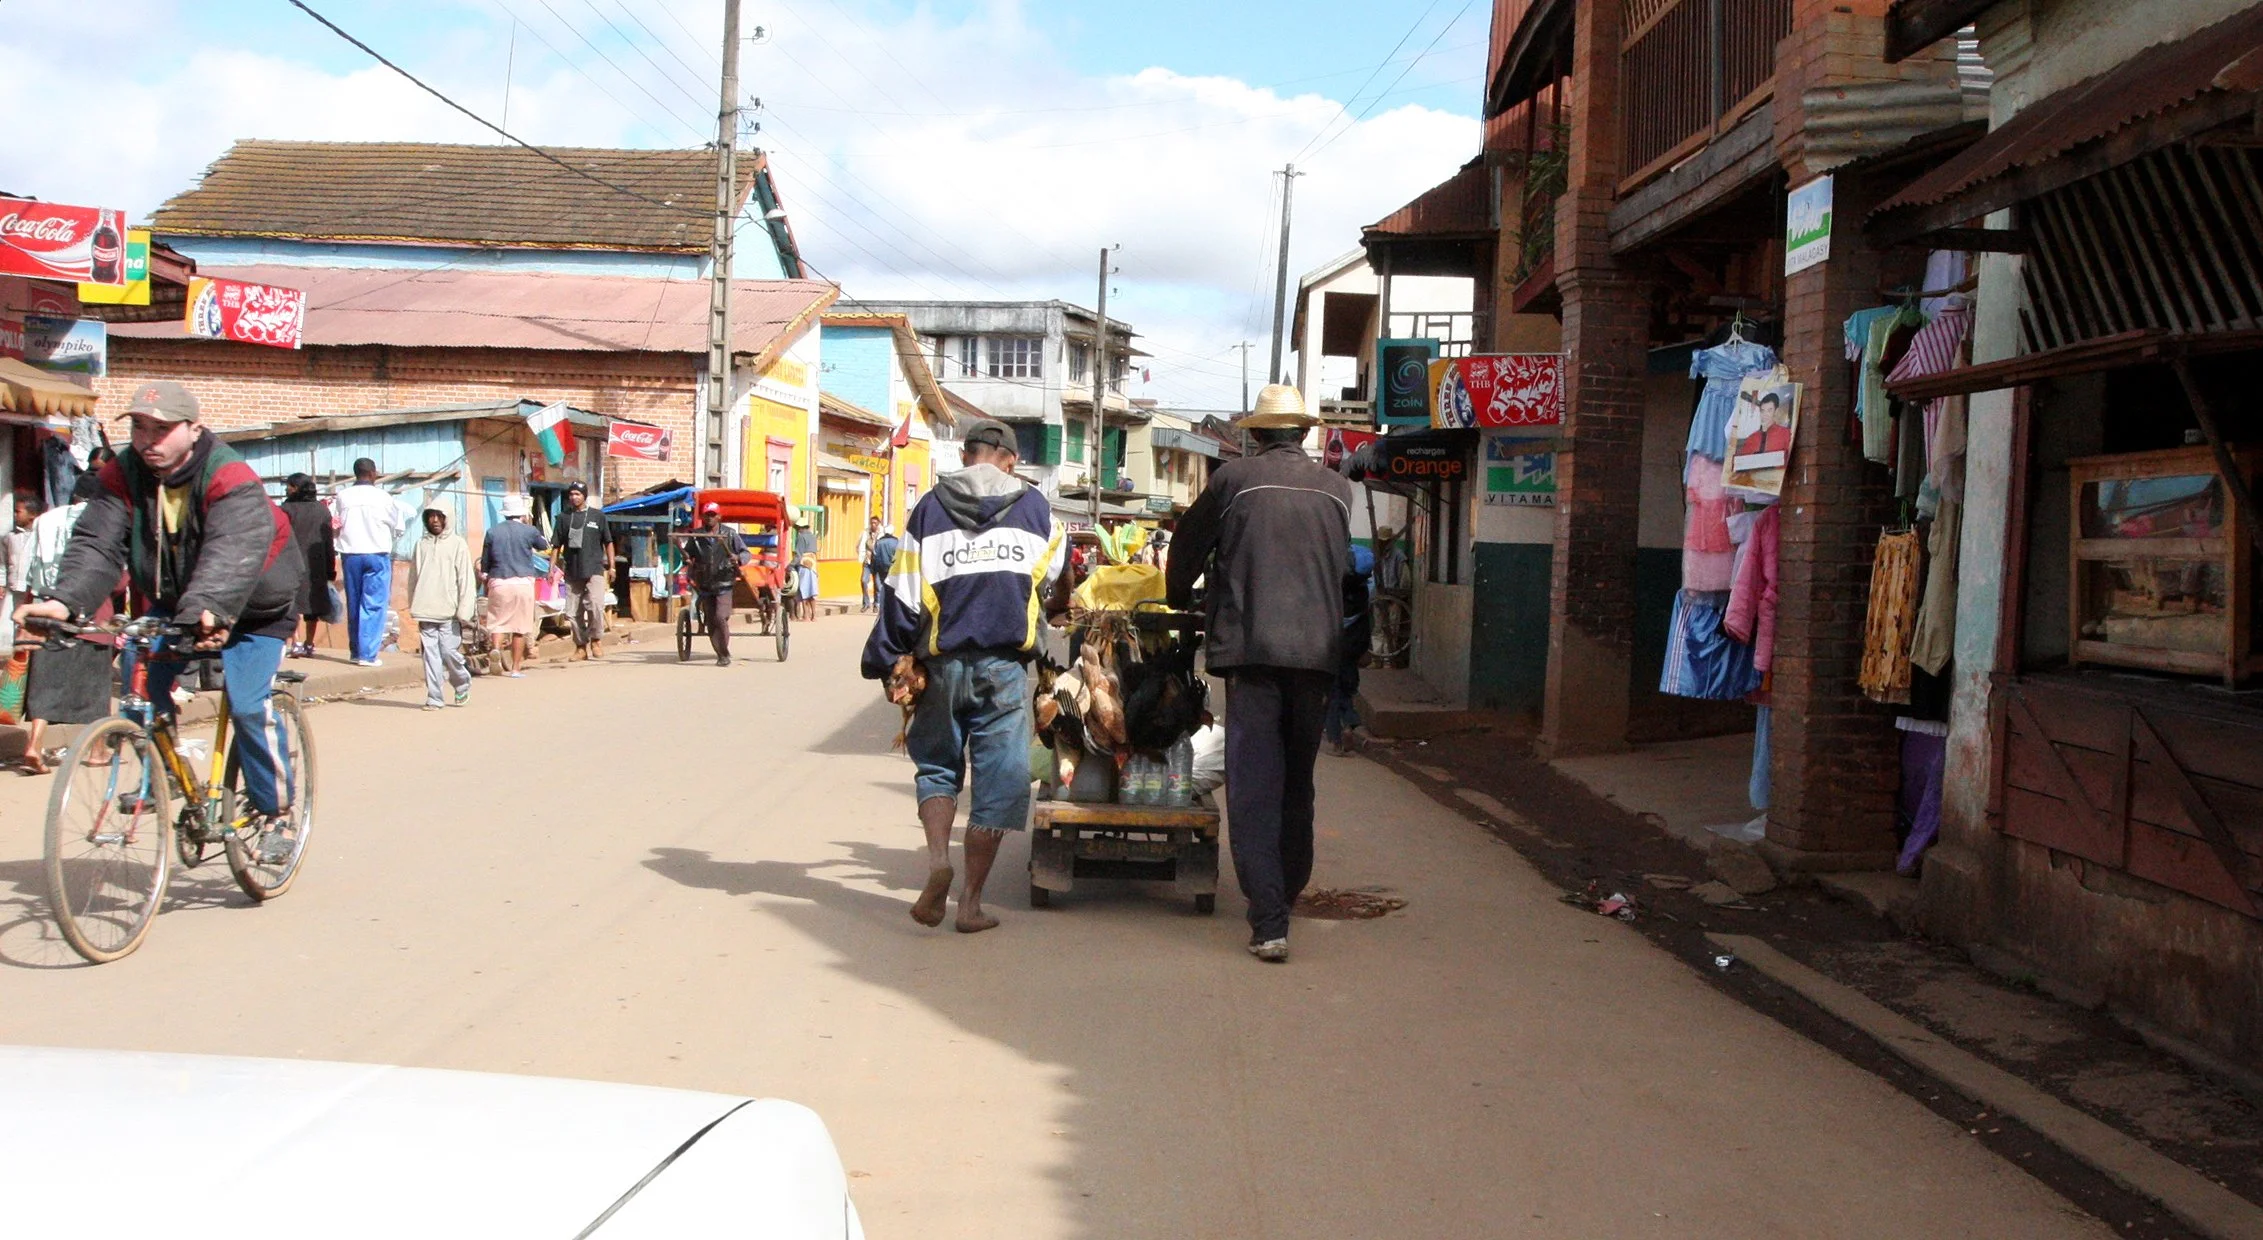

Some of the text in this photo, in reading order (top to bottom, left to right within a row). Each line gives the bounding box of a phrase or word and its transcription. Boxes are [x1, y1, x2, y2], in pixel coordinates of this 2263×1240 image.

[0, 213, 79, 242] Coca-Cola
[34, 336, 93, 353] olympiko
[1470, 380, 1491, 388] THB
[1444, 382, 1456, 427] THREE
[1406, 447, 1446, 457] recharges
[1391, 456, 1462, 478] Orange
